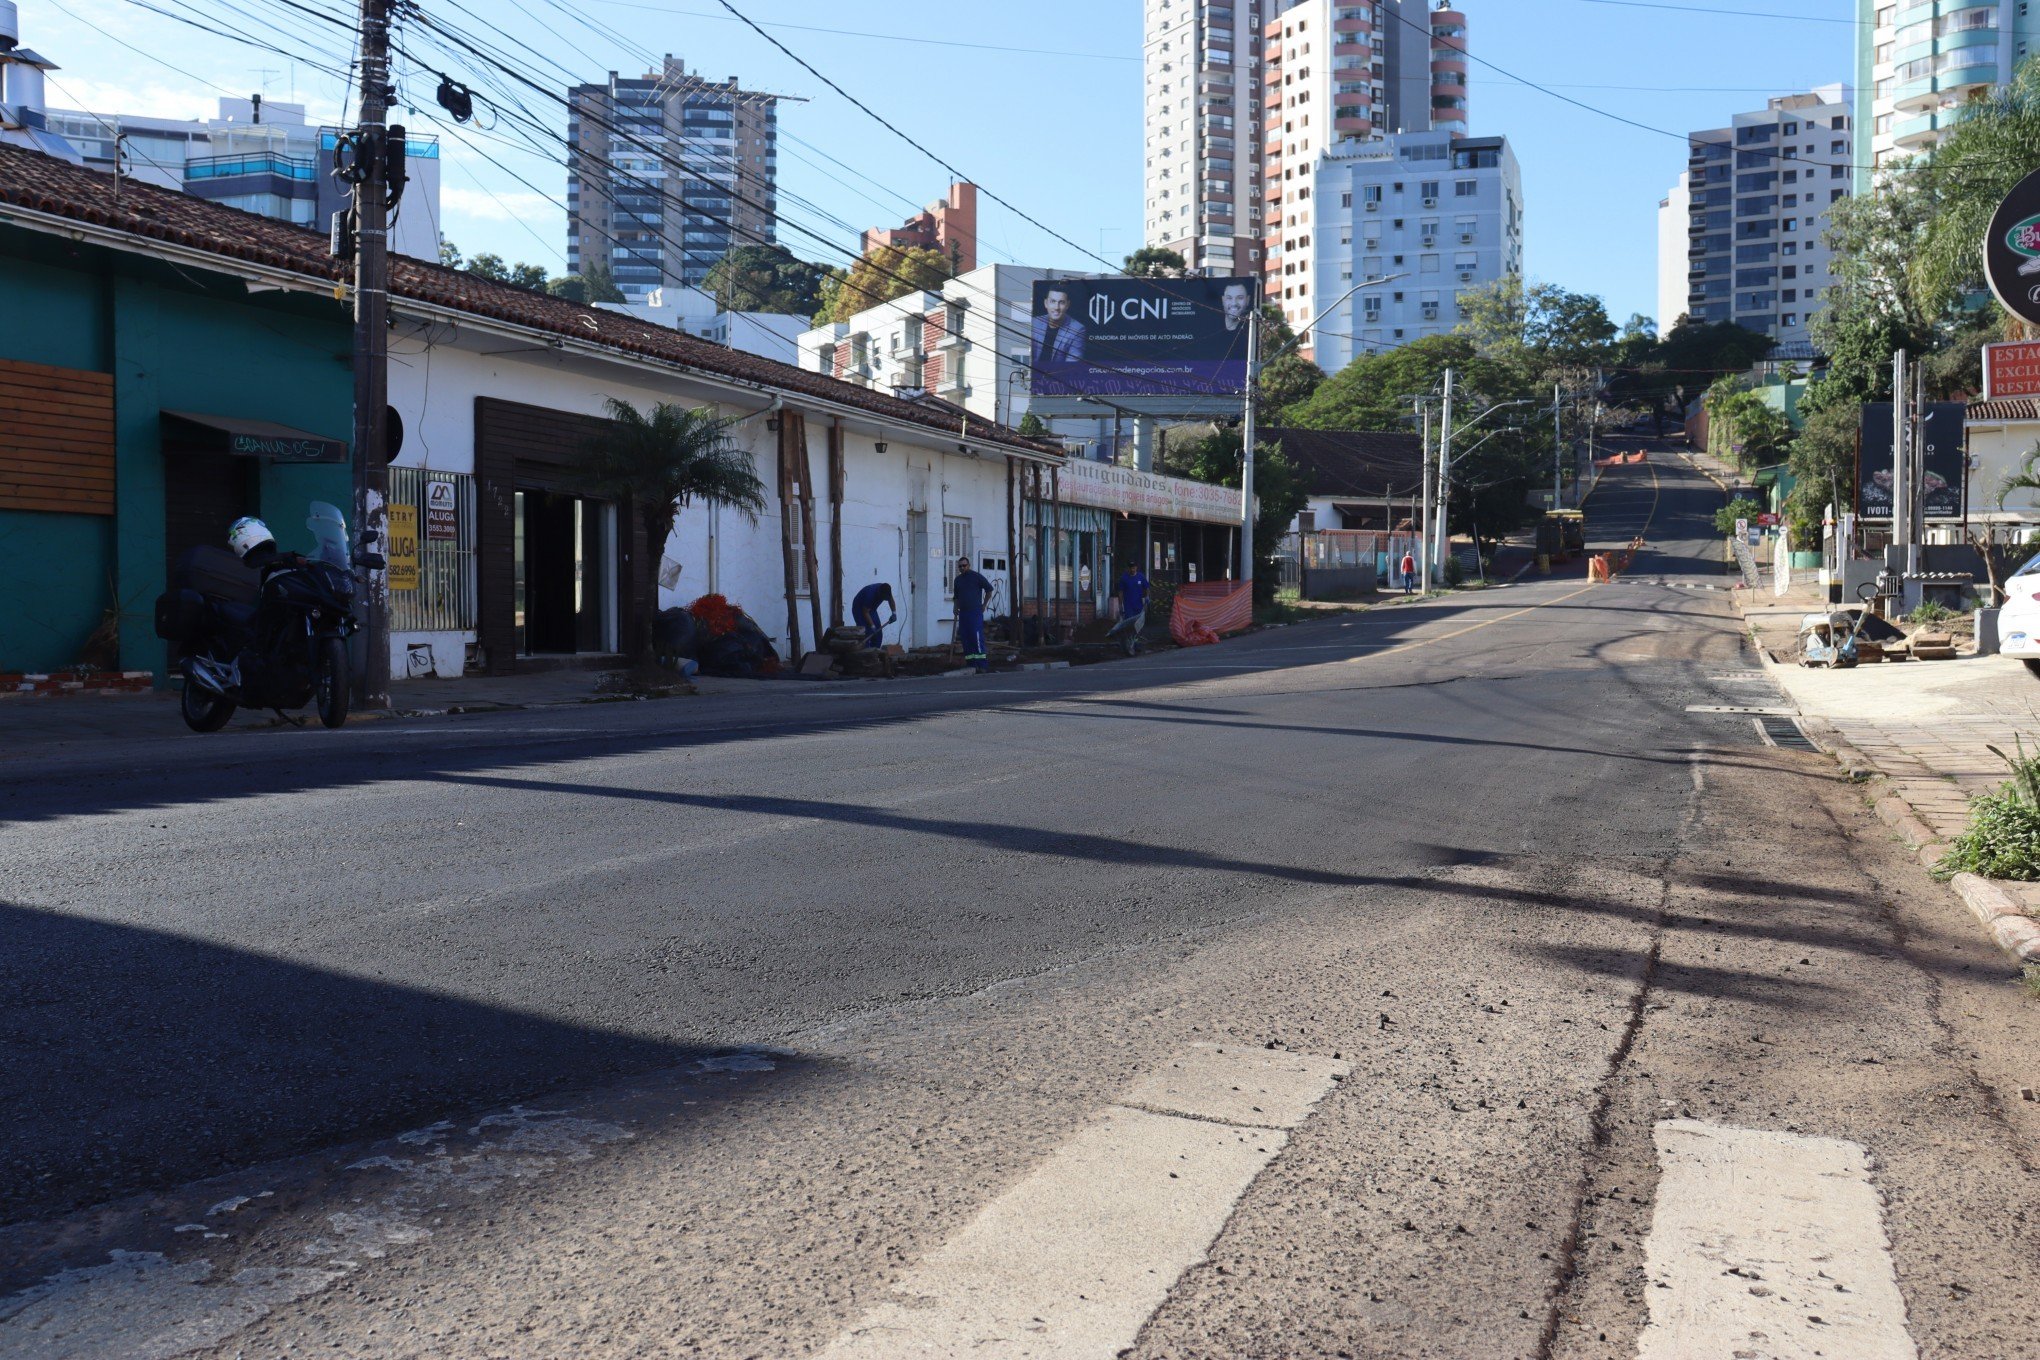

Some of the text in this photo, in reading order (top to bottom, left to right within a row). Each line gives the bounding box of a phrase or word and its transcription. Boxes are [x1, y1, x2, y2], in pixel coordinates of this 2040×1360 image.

[1121, 298, 1168, 320] CNI
[1061, 461, 1166, 492] Antiguidades
[428, 510, 455, 522] ALUGA
[1867, 506, 1893, 515] IVOTI-
